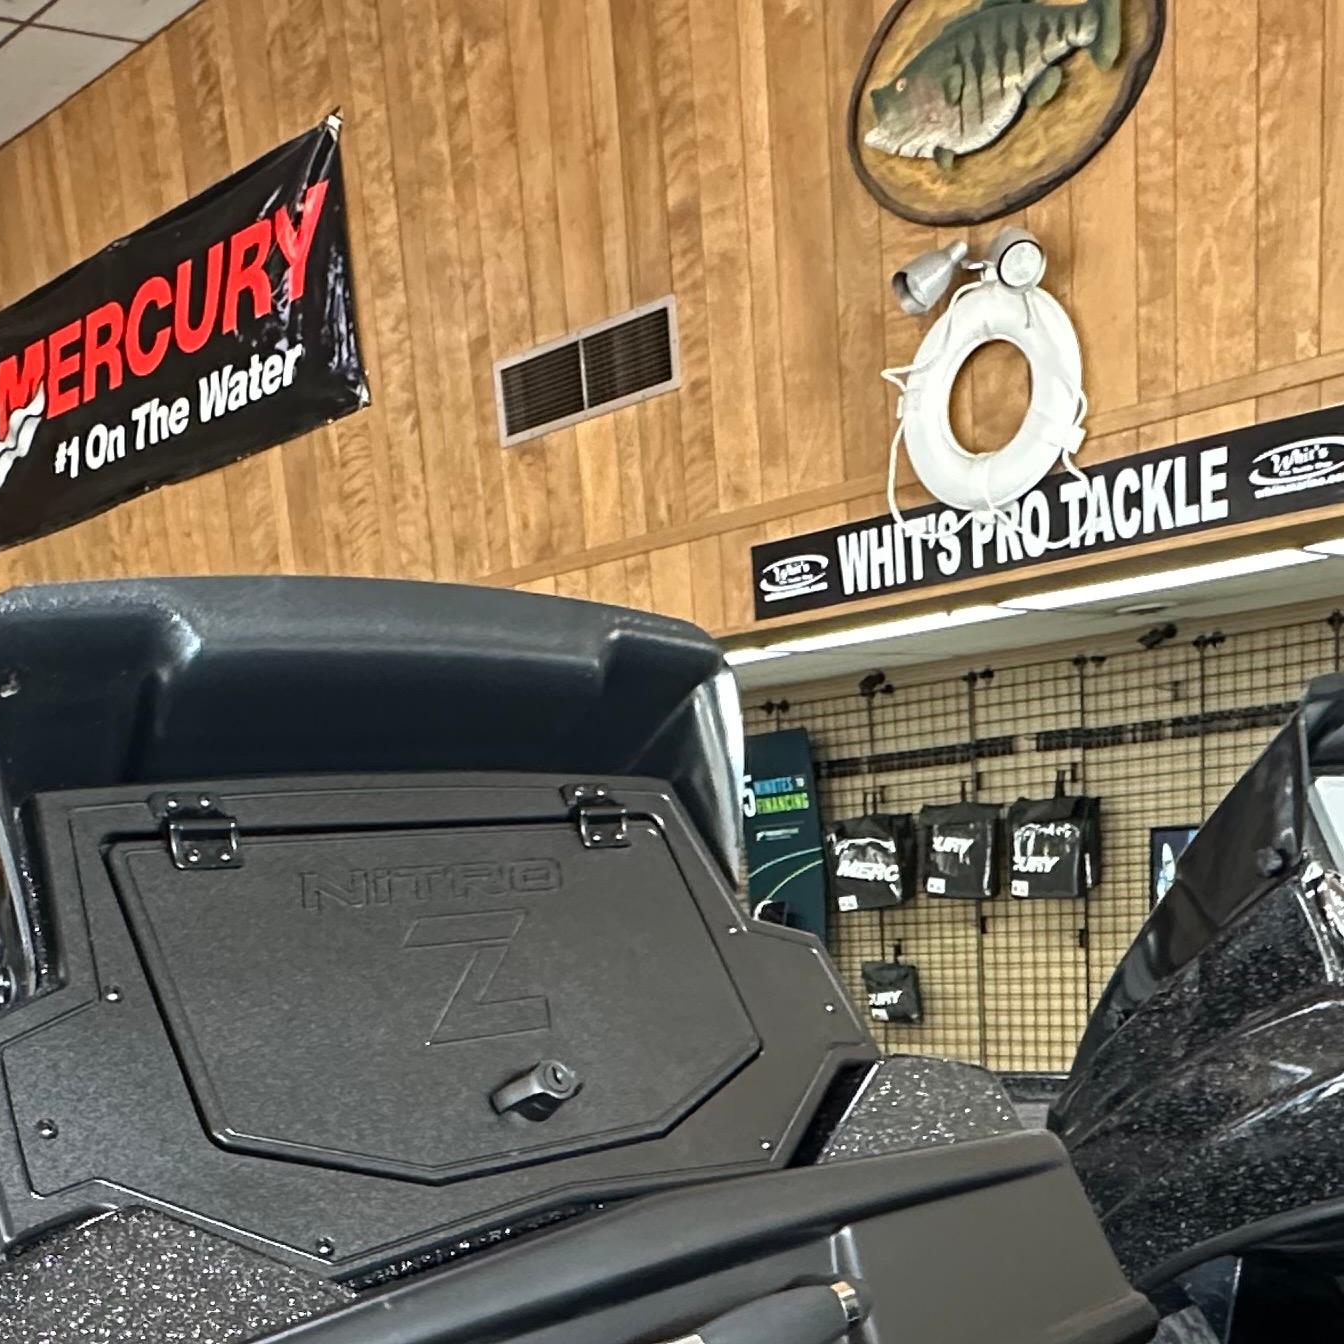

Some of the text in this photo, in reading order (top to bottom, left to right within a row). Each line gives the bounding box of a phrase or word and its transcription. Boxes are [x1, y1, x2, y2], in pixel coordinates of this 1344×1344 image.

[54, 343, 305, 479] #1 On The Water
[837, 445, 1229, 596] WHIT'S PRO TACKLE
[299, 857, 563, 911] NITRO
[401, 907, 552, 1046] Z
